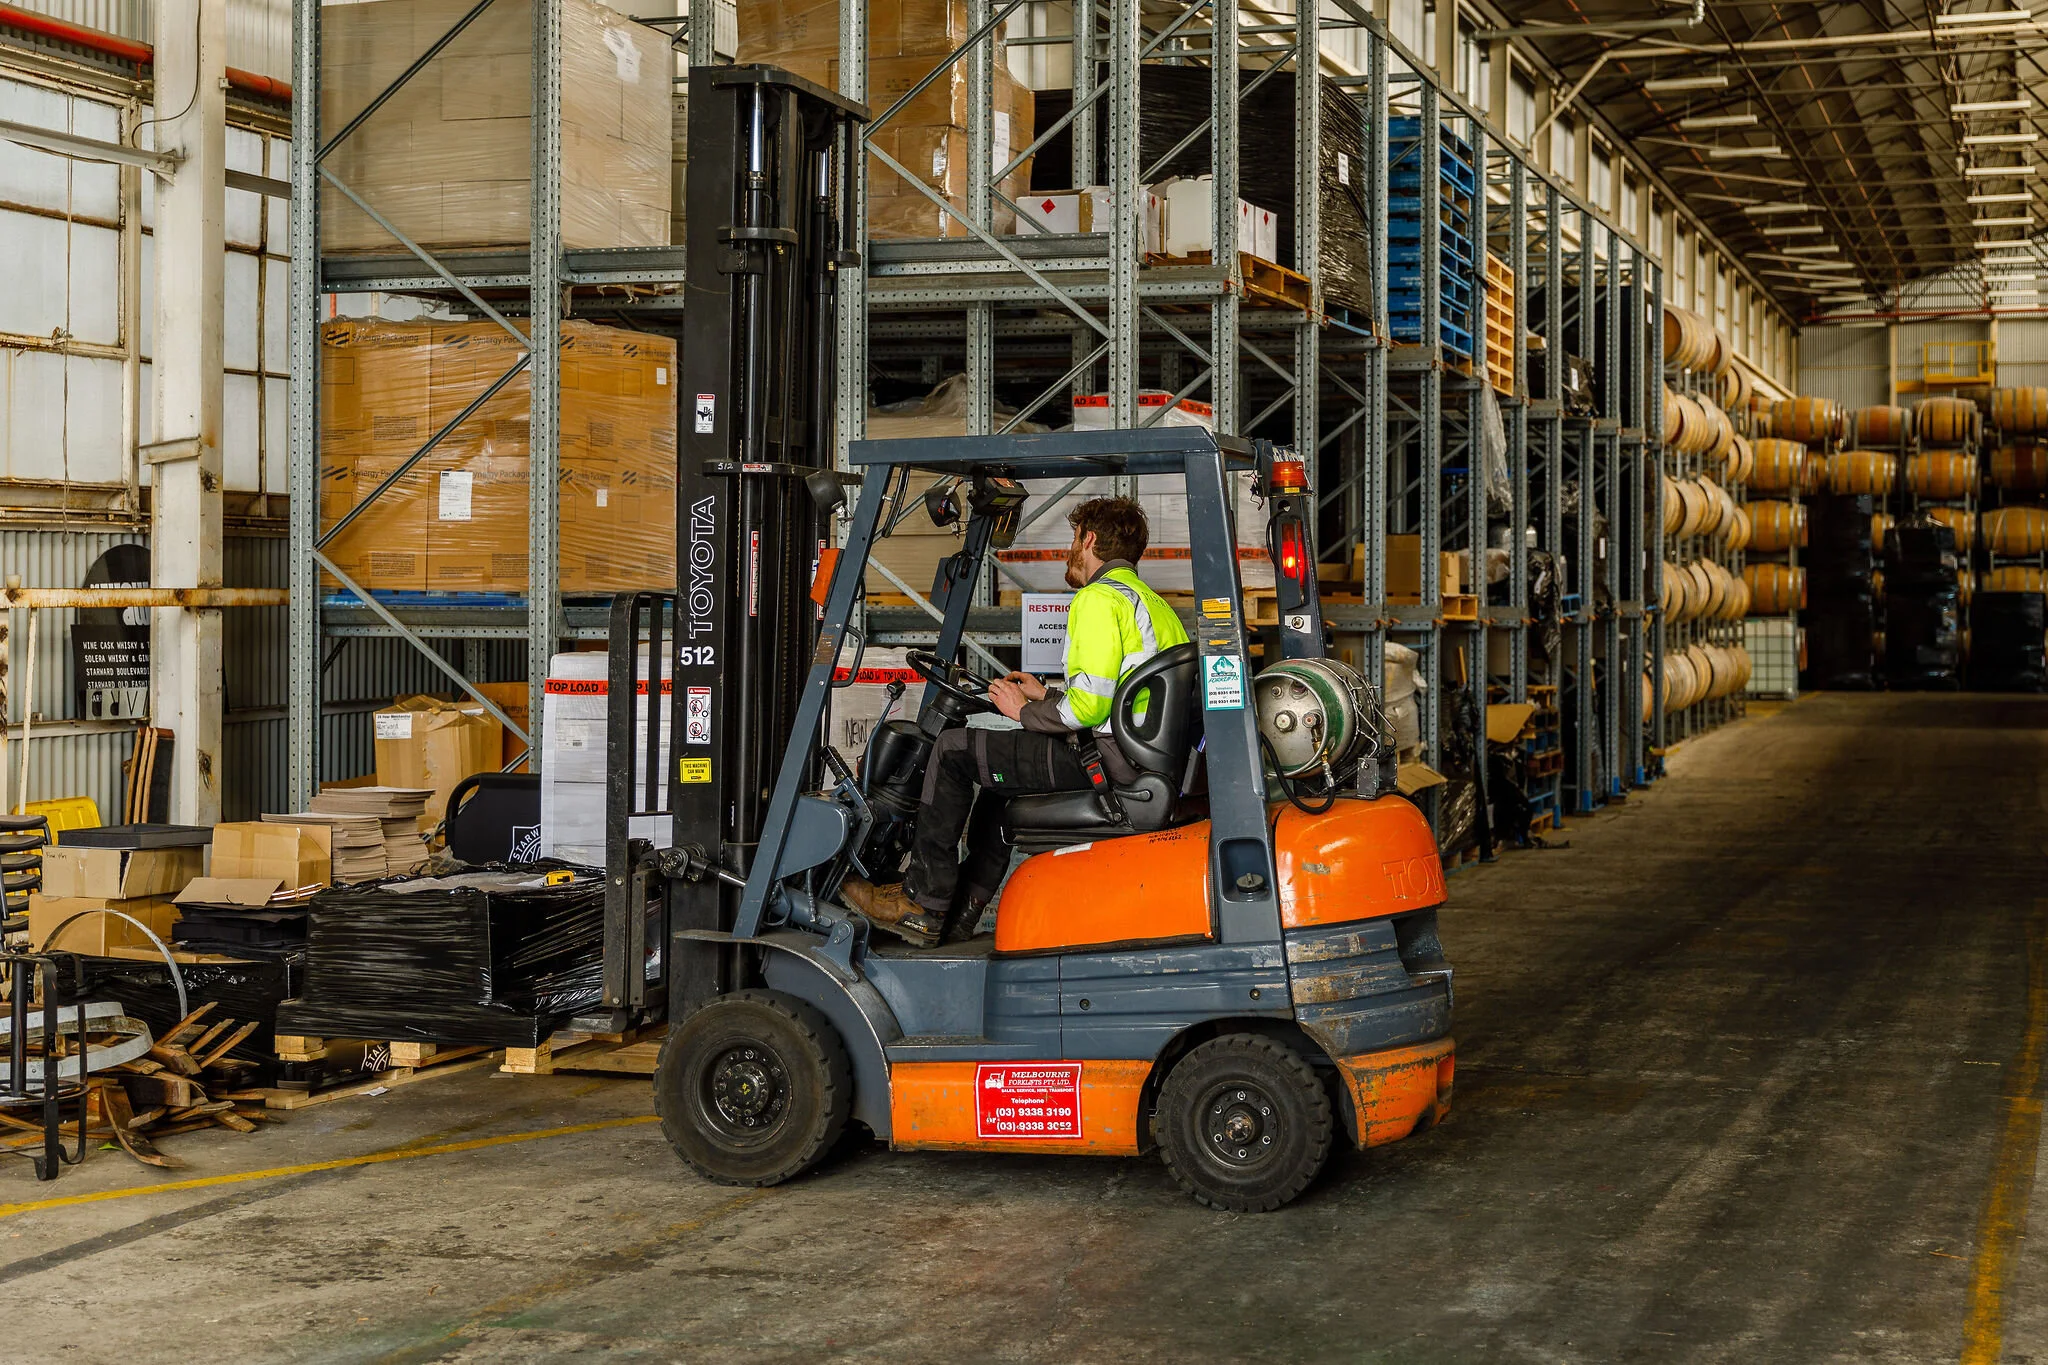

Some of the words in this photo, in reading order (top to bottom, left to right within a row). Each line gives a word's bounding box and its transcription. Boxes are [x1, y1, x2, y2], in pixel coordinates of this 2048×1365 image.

[717, 462, 734, 470] 512
[351, 469, 380, 481] Synergy
[689, 495, 715, 639] TOYOTA
[83, 641, 98, 650] WINE
[100, 641, 115, 650] CASK
[116, 641, 138, 650] WHISKY
[84, 654, 106, 663] SOLERA
[108, 654, 129, 663] WHISKY
[680, 645, 715, 666] 512
[86, 667, 114, 676] STARWARD
[117, 680, 129, 688] OLD
[547, 682, 568, 692] TOP
[570, 682, 599, 692] LOAD
[845, 717, 868, 748] NEW
[1011, 1071, 1071, 1079] MELBOURNE
[1011, 1097, 1045, 1105] Telephone
[995, 1107, 1015, 1118] (03)
[1018, 1107, 1043, 1117] 9338
[1046, 1107, 1071, 1116] 3190
[996, 1121, 1016, 1132] (03)
[1019, 1121, 1044, 1131] 9338
